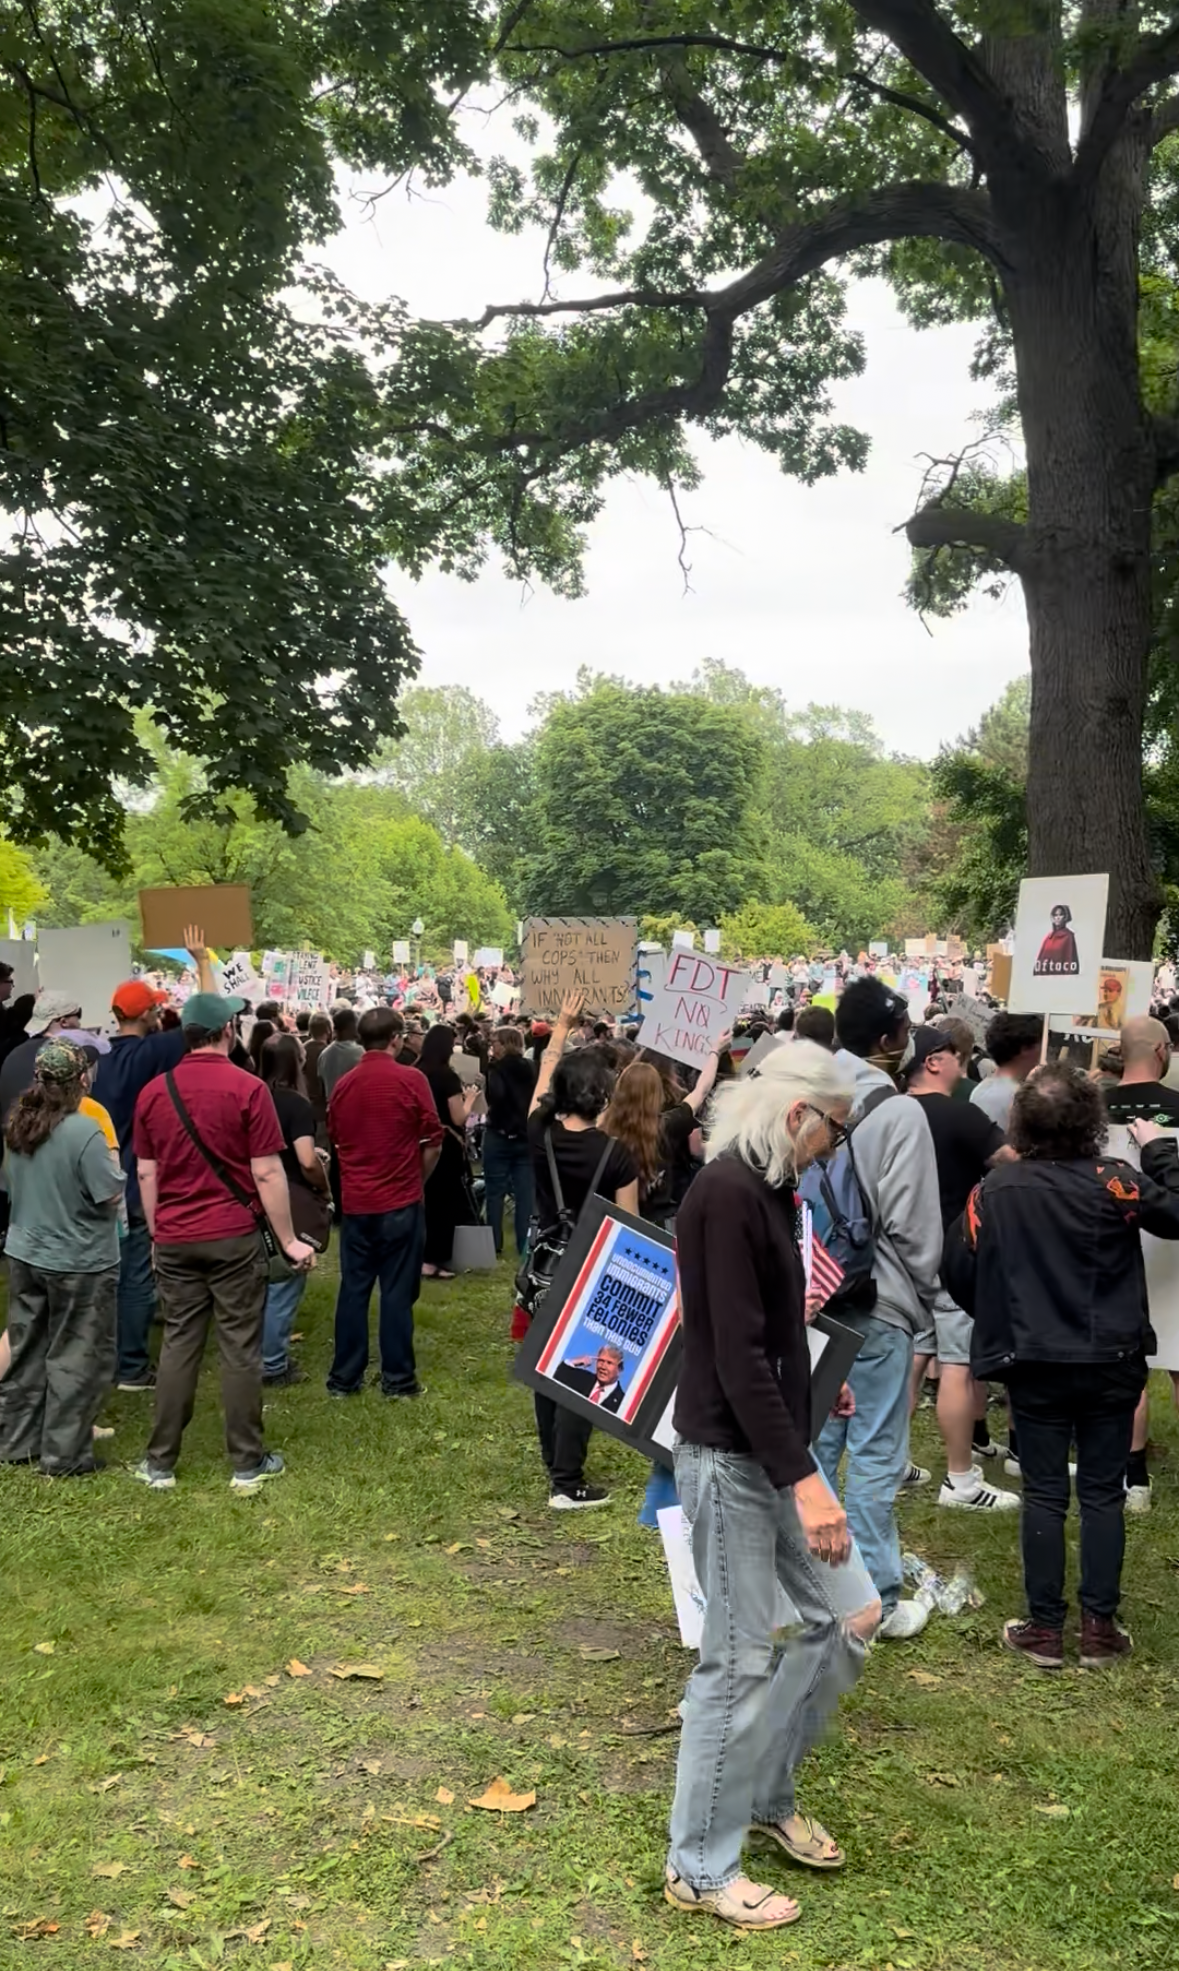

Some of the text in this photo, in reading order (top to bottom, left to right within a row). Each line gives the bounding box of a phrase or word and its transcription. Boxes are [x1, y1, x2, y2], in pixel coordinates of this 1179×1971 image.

[532, 932, 547, 948] IF
[585, 931, 607, 946] ALL
[223, 963, 243, 980] WE
[587, 950, 620, 964] THEN
[531, 968, 600, 985] WHY ALL
[670, 953, 742, 1000] FDT
[655, 1022, 713, 1055] KINGS
[594, 1291, 654, 1332] 34 FEWER
[600, 1274, 663, 1319] COMMIT
[586, 1303, 648, 1347] FELONIES
[605, 1329, 624, 1346] THIS
[622, 1338, 643, 1357] GUY
